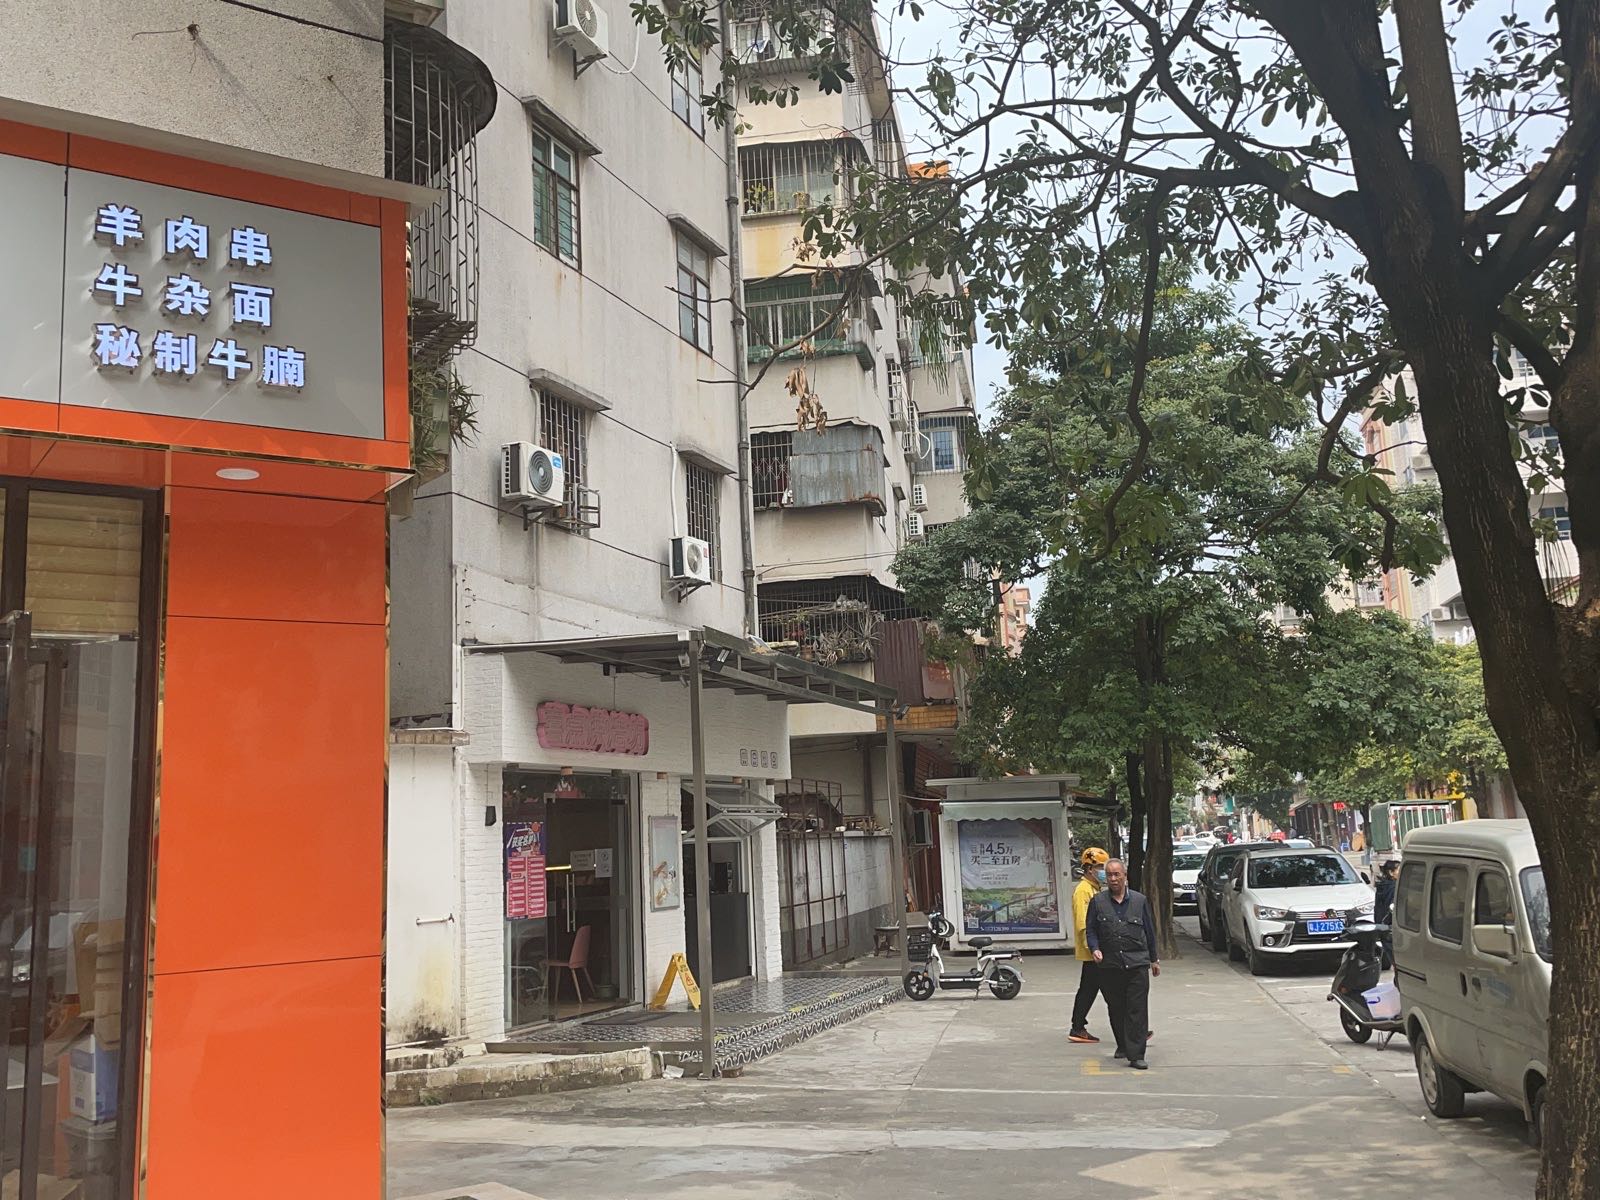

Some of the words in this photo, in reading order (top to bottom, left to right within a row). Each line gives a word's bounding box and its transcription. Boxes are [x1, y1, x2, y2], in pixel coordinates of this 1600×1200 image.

[96, 203, 273, 267] 羊肉串
[95, 263, 274, 327] 牛杂面
[95, 323, 307, 388] 秘制牛腩
[971, 855, 1021, 866] 买二至五房
